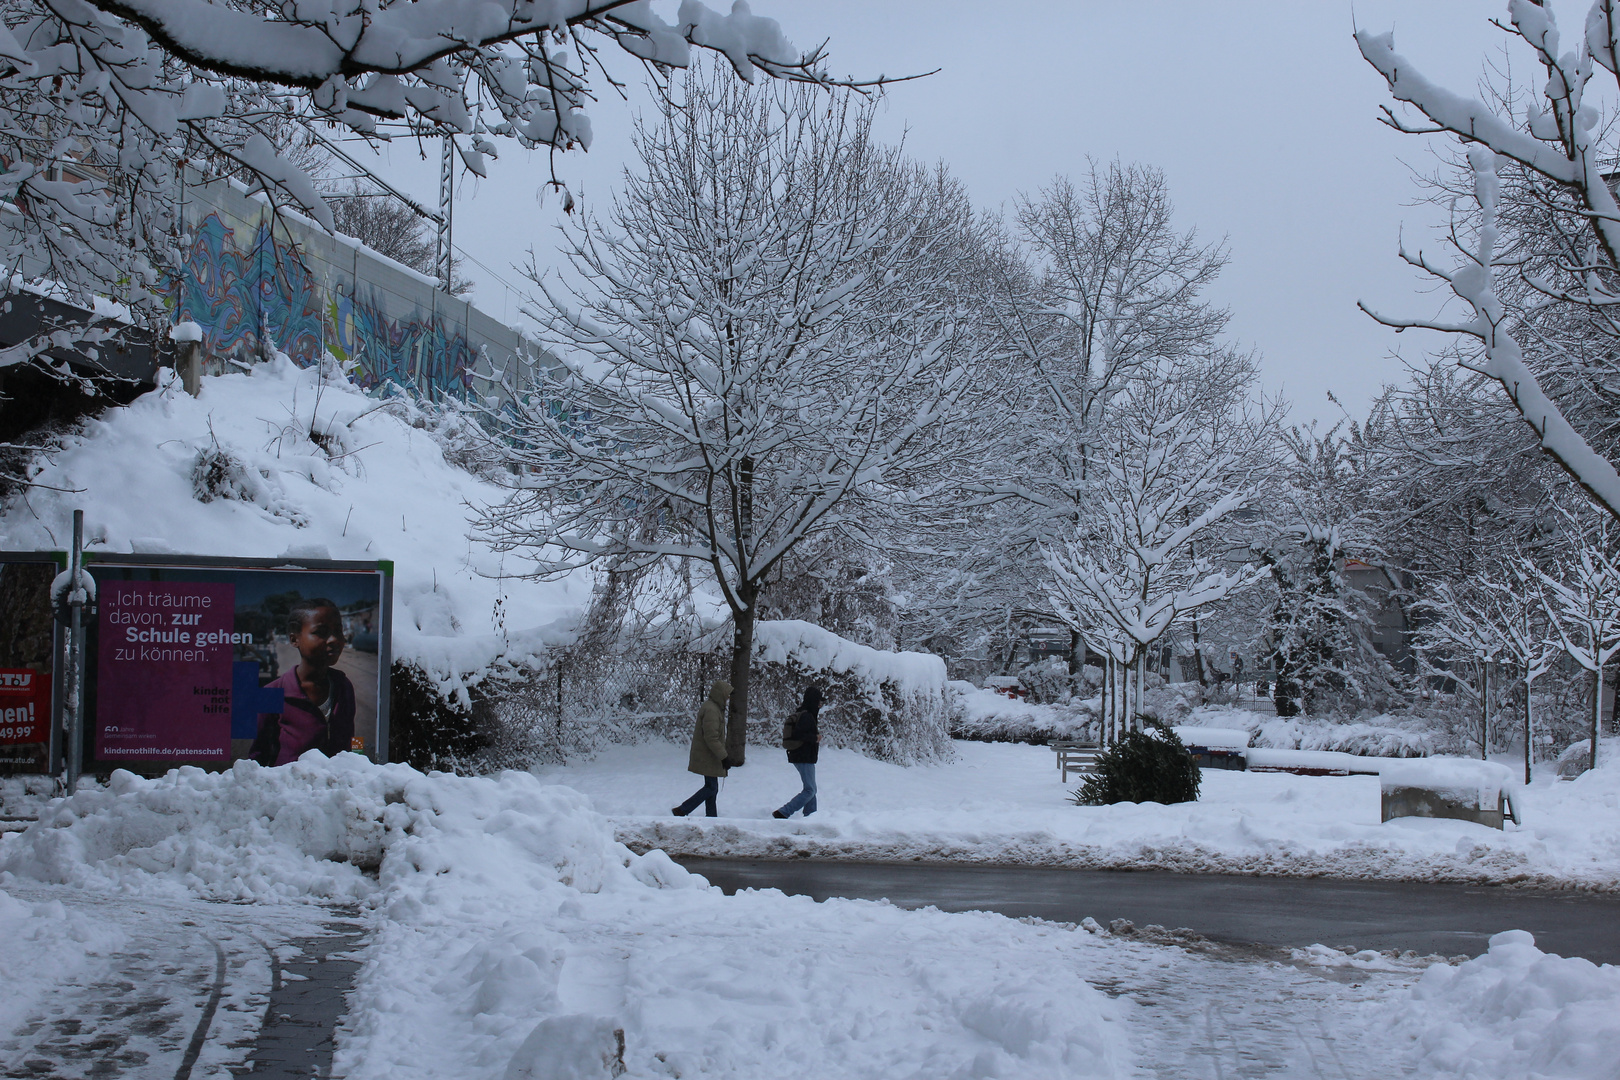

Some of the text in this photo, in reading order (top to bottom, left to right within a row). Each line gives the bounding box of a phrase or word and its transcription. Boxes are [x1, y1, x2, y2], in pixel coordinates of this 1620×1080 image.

[148, 591, 211, 608] träume
[109, 609, 202, 626] davon, zur
[126, 627, 253, 647] Schule gehen
[115, 648, 135, 661] zu
[193, 686, 230, 696] kinder
[211, 696, 230, 704] not
[203, 704, 230, 713] hilfe
[104, 747, 223, 756] kindernothilfe.de/patenschaft
